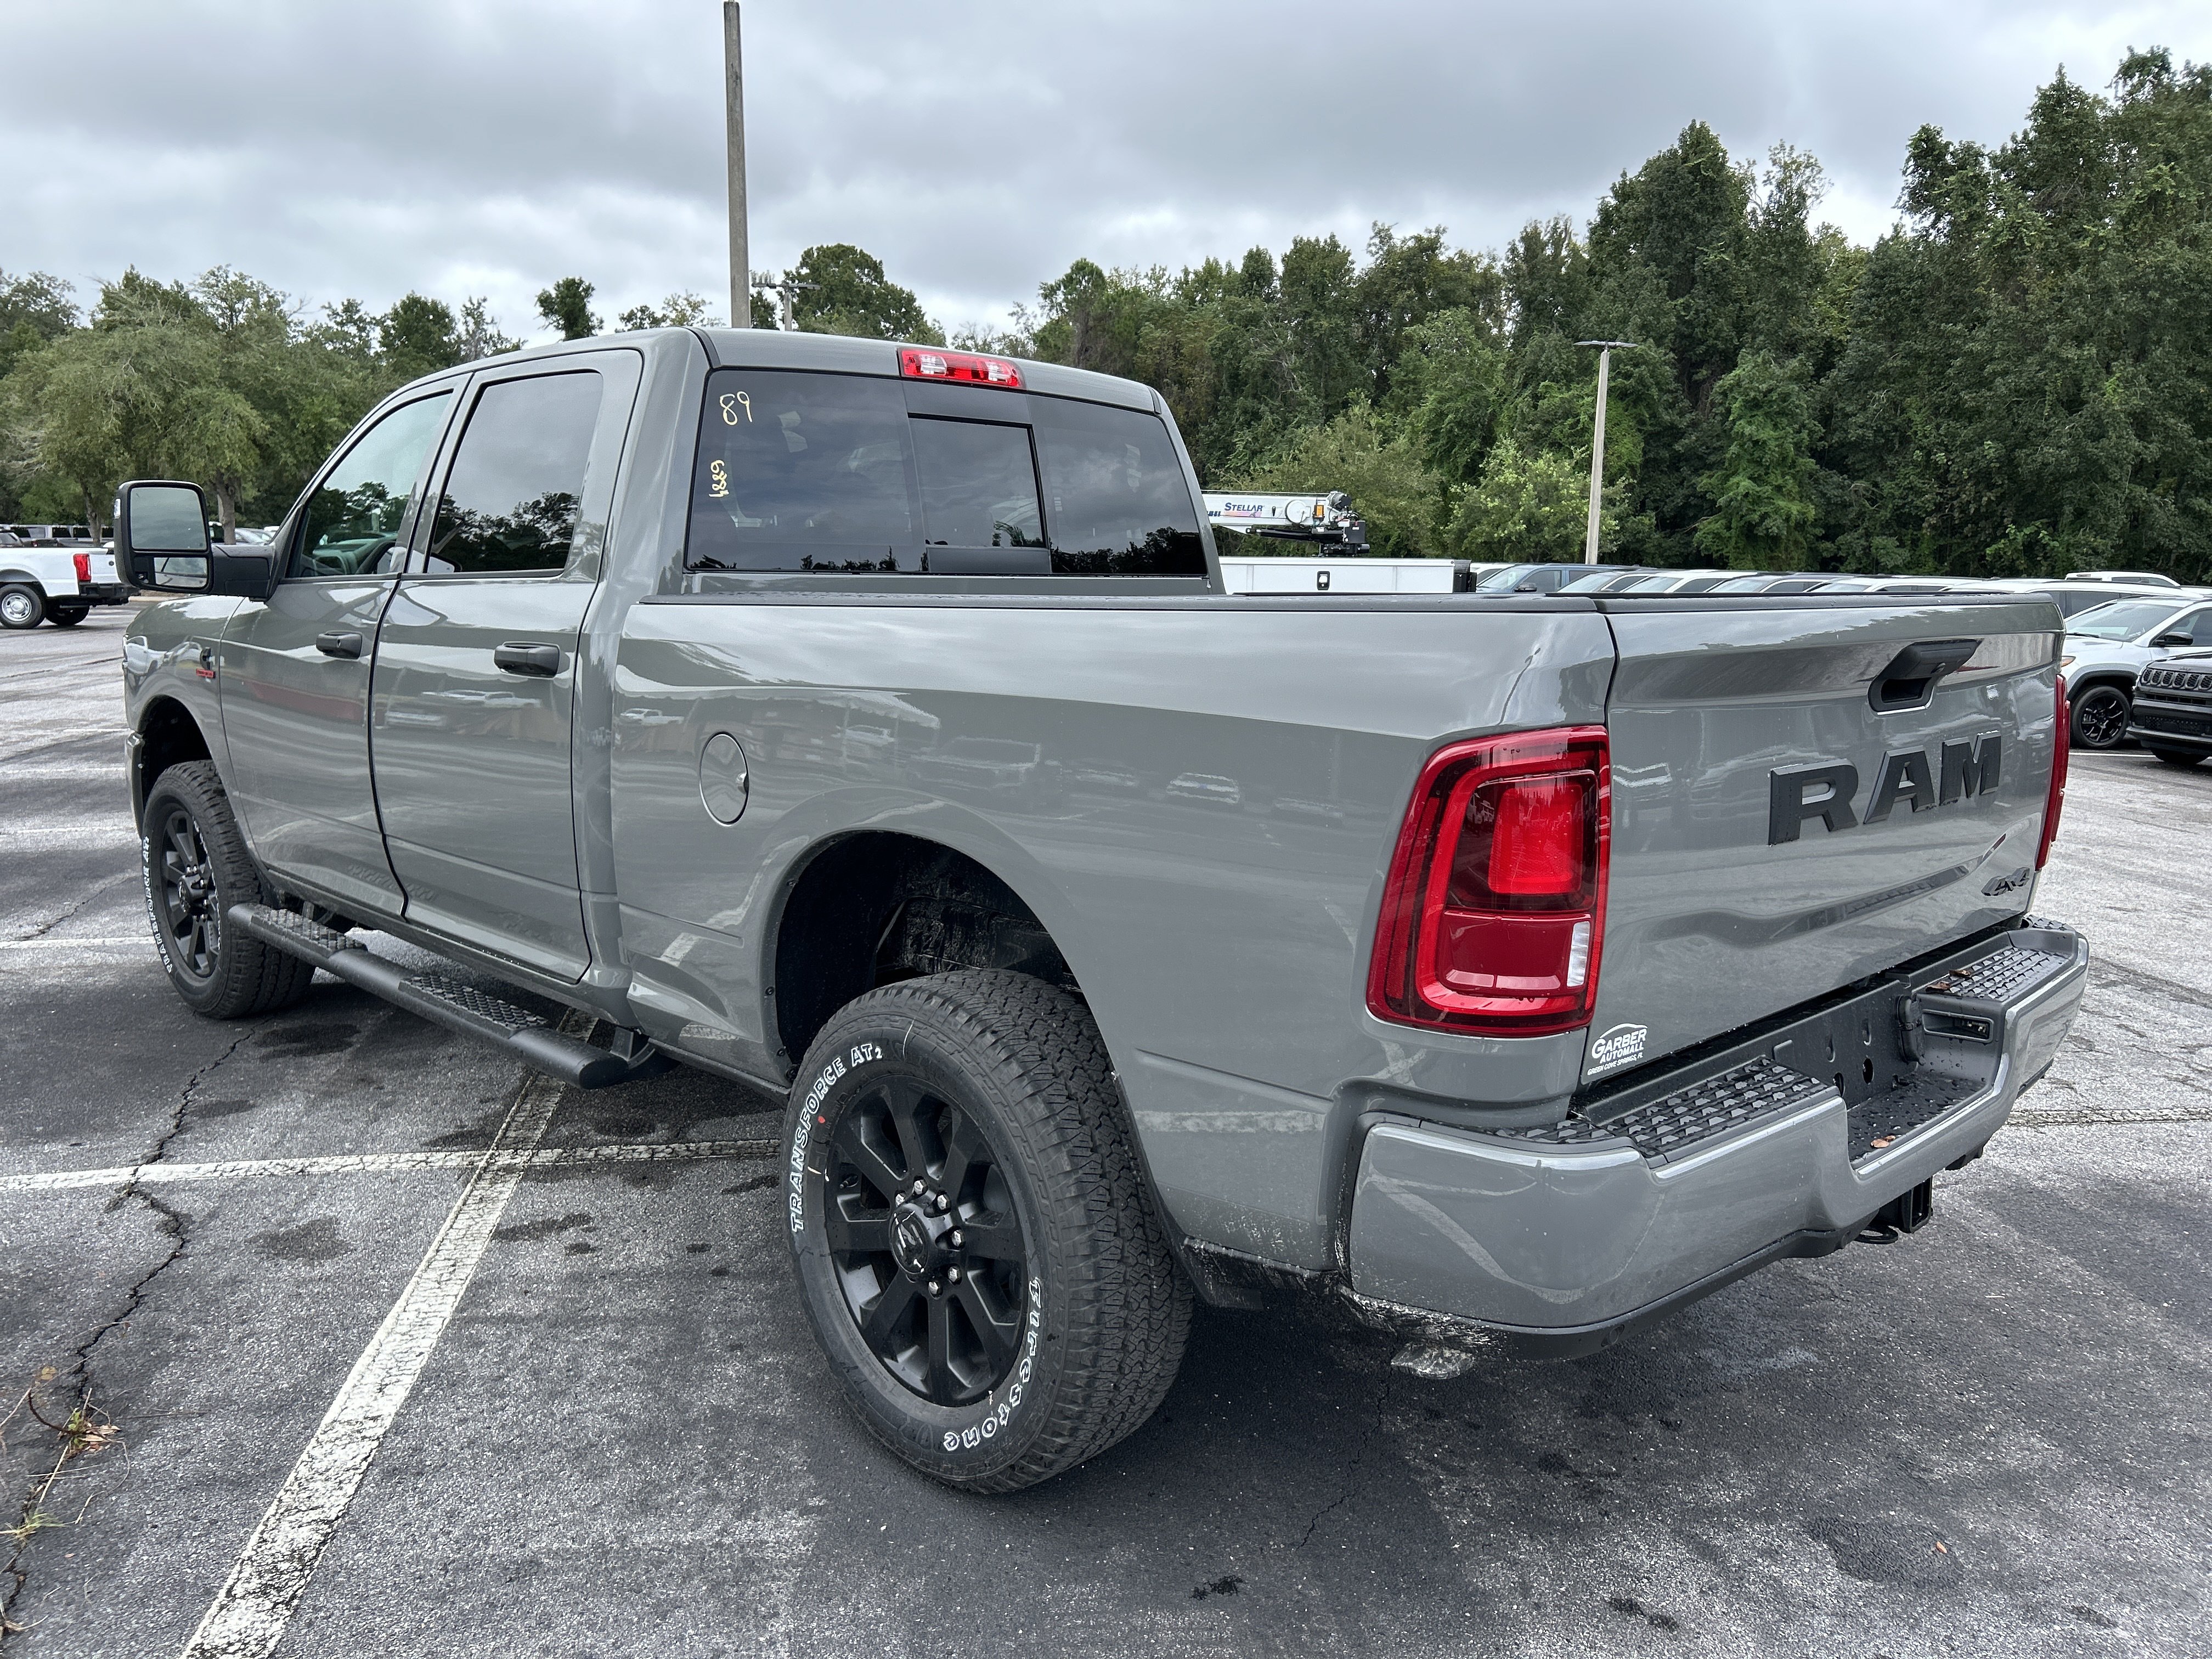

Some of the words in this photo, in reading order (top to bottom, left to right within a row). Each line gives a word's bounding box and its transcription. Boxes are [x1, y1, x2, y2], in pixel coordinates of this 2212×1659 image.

[719, 391, 753, 426] 89
[1224, 502, 1263, 512] STELLAR
[1768, 730, 2002, 847] RAM
[1592, 1028, 1647, 1059] GARBER
[1599, 1042, 1644, 1064] AUTOMALL
[1604, 1060, 1617, 1070] COVE
[789, 1056, 847, 1233] TRANSFORCE
[943, 1277, 1042, 1452] Firestone
